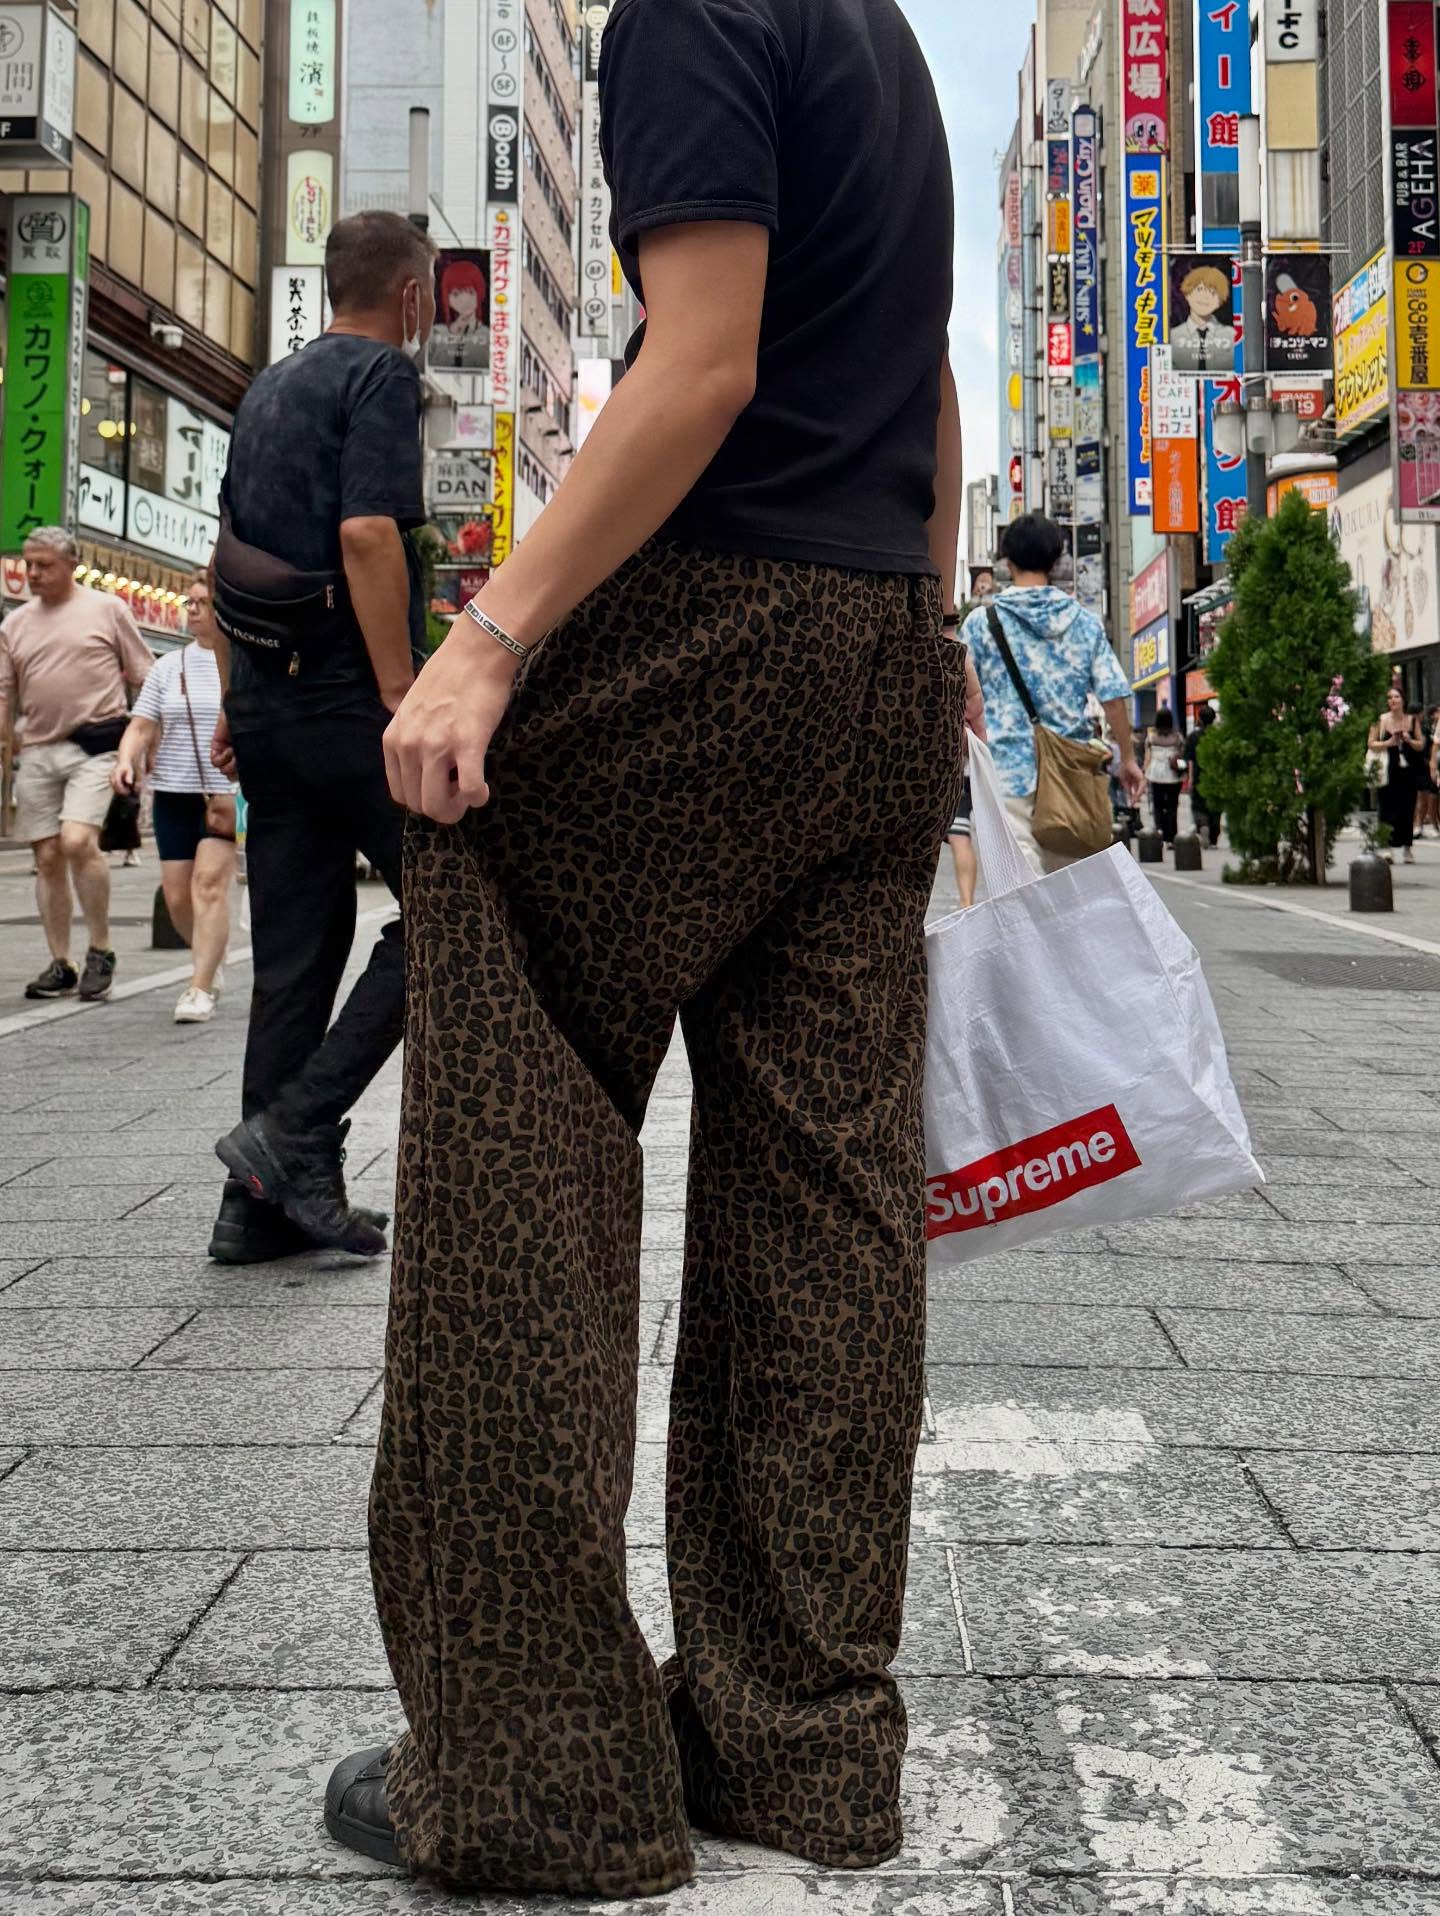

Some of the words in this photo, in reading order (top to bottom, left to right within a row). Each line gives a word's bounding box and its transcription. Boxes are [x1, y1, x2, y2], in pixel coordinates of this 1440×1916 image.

[489, 115, 517, 190] Booth
[1395, 142, 1409, 165] BAR
[1397, 166, 1409, 179] &
[1397, 180, 1410, 206] PUB
[1273, 336, 1328, 348] チェンソーマン
[1157, 387, 1191, 399] CAFE
[1158, 421, 1192, 434] カフェ
[437, 481, 487, 499] DAN
[926, 1131, 1117, 1222] Supreme
